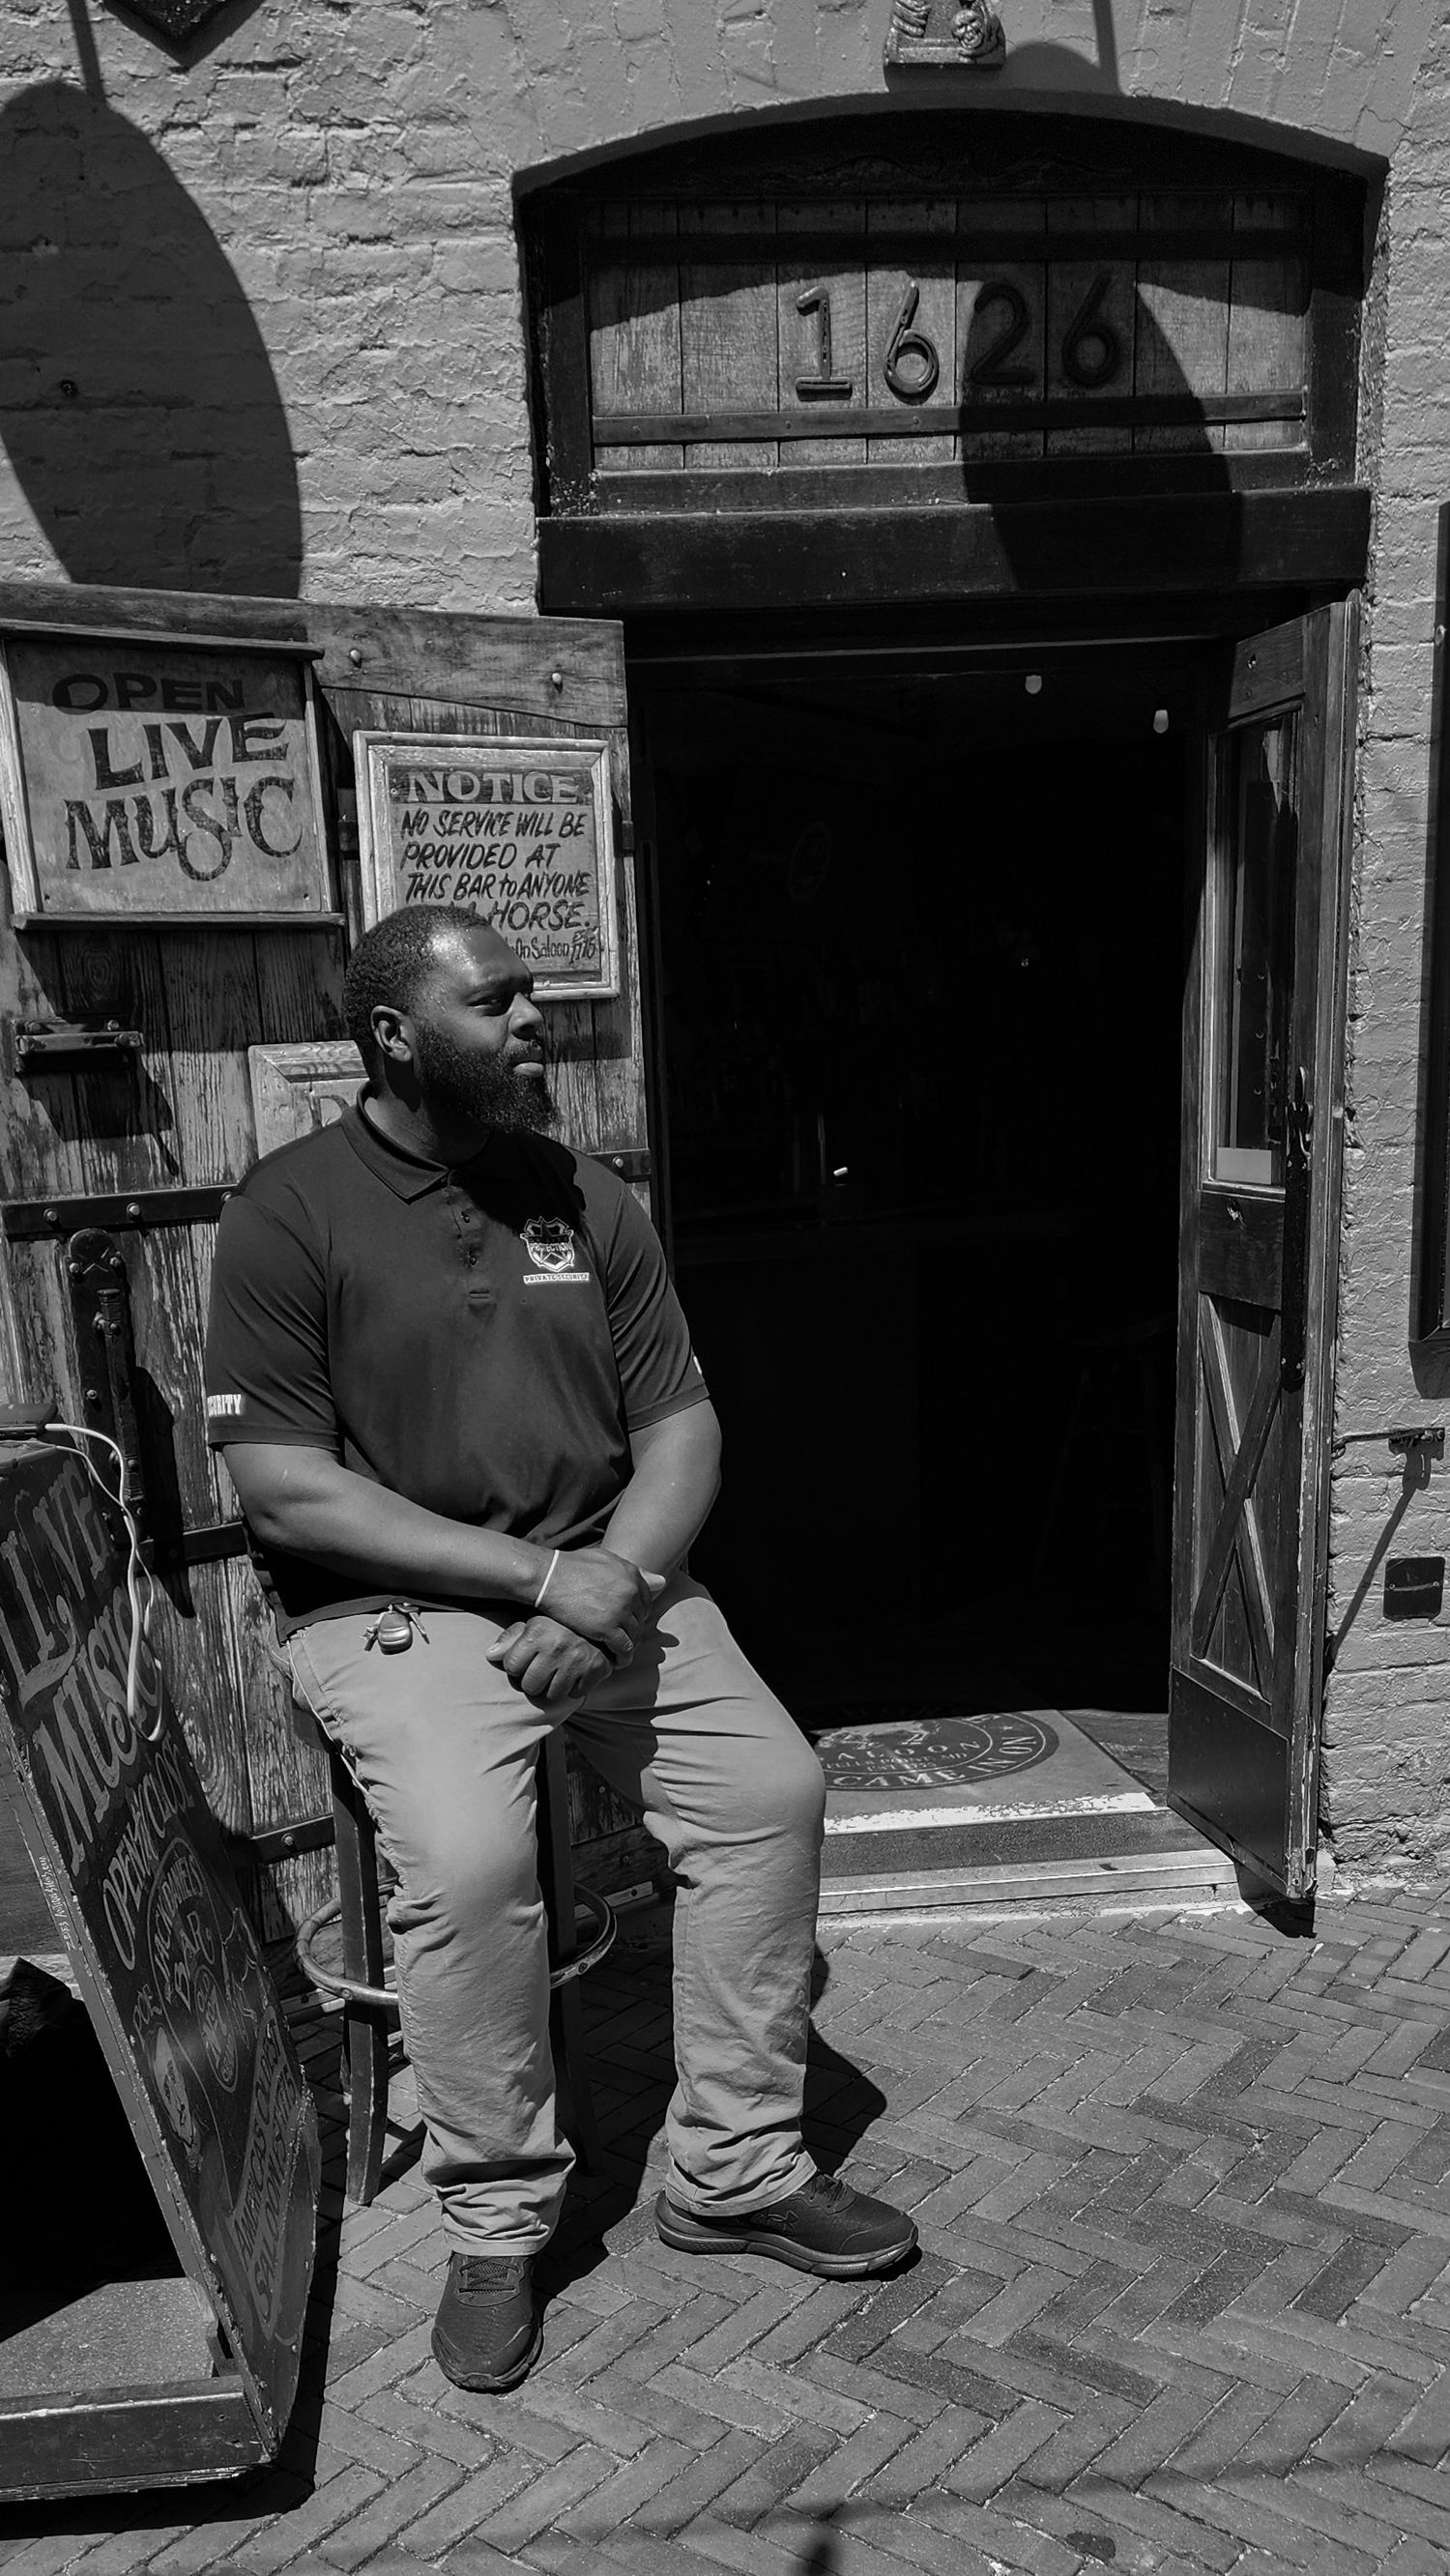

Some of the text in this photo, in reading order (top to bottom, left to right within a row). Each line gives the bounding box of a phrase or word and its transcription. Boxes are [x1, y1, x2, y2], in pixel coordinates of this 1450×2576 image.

[796, 271, 1120, 399] 1626
[52, 673, 245, 715] OPEN
[87, 712, 289, 791] LIVE
[407, 771, 579, 803] NOTICE
[62, 775, 304, 882] MUSIC
[400, 807, 588, 839] NO SERVICE WILL BE
[400, 841, 561, 870] PROVIDED AT
[406, 870, 592, 903] THIS BAR to ANYONE
[487, 899, 591, 931] HORSE.
[531, 935, 569, 960] Saloon
[32, 1585, 160, 1878] MUSIC
[833, 1769, 966, 1786] CAME
[999, 1736, 1037, 1754] ON
[102, 1821, 151, 1971] OPEN
[174, 1911, 215, 2013] BAR
[254, 2148, 281, 2320] SALOON
